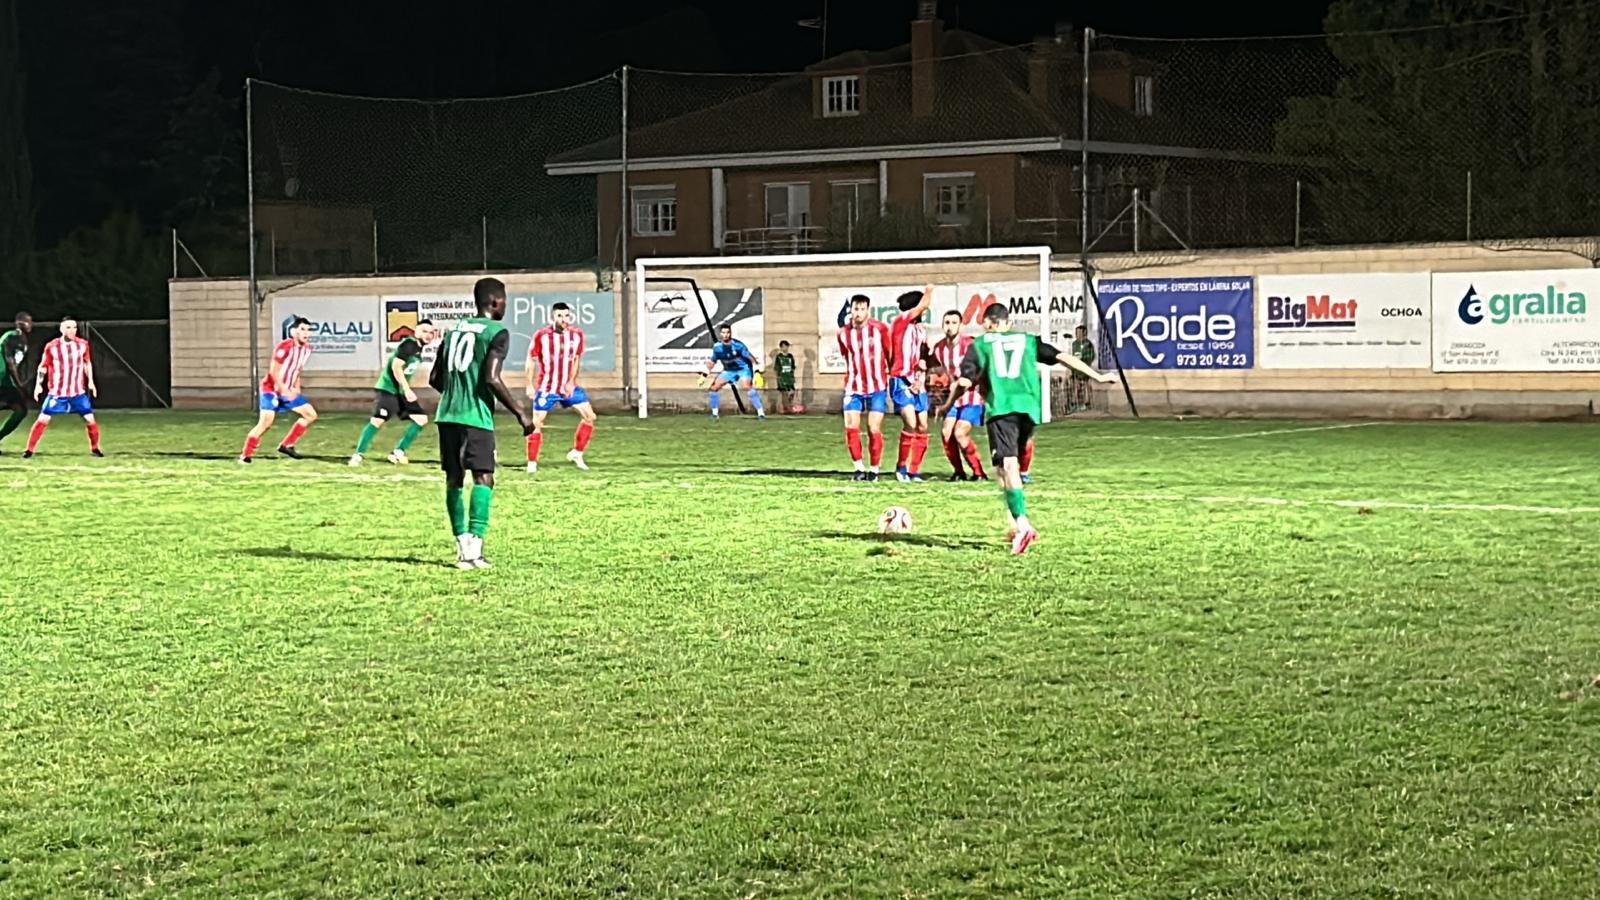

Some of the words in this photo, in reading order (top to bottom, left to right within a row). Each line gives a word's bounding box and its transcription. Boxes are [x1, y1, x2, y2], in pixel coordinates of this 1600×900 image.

[1172, 282, 1199, 292] EXPERTOS
[455, 301, 463, 309] DE
[464, 301, 474, 309] PIE
[1008, 296, 1085, 314] MAANA
[1267, 295, 1357, 327] BigMat
[1381, 308, 1423, 317] OCHOA
[307, 321, 373, 335] PALAU
[1105, 296, 1236, 364] Roide
[447, 332, 476, 373] 10
[1208, 342, 1235, 350] 1969
[992, 333, 1026, 379] 17
[1177, 354, 1197, 366] 973
[1199, 354, 1213, 366] 20
[1216, 354, 1229, 366] 42
[1232, 354, 1247, 366] 23
